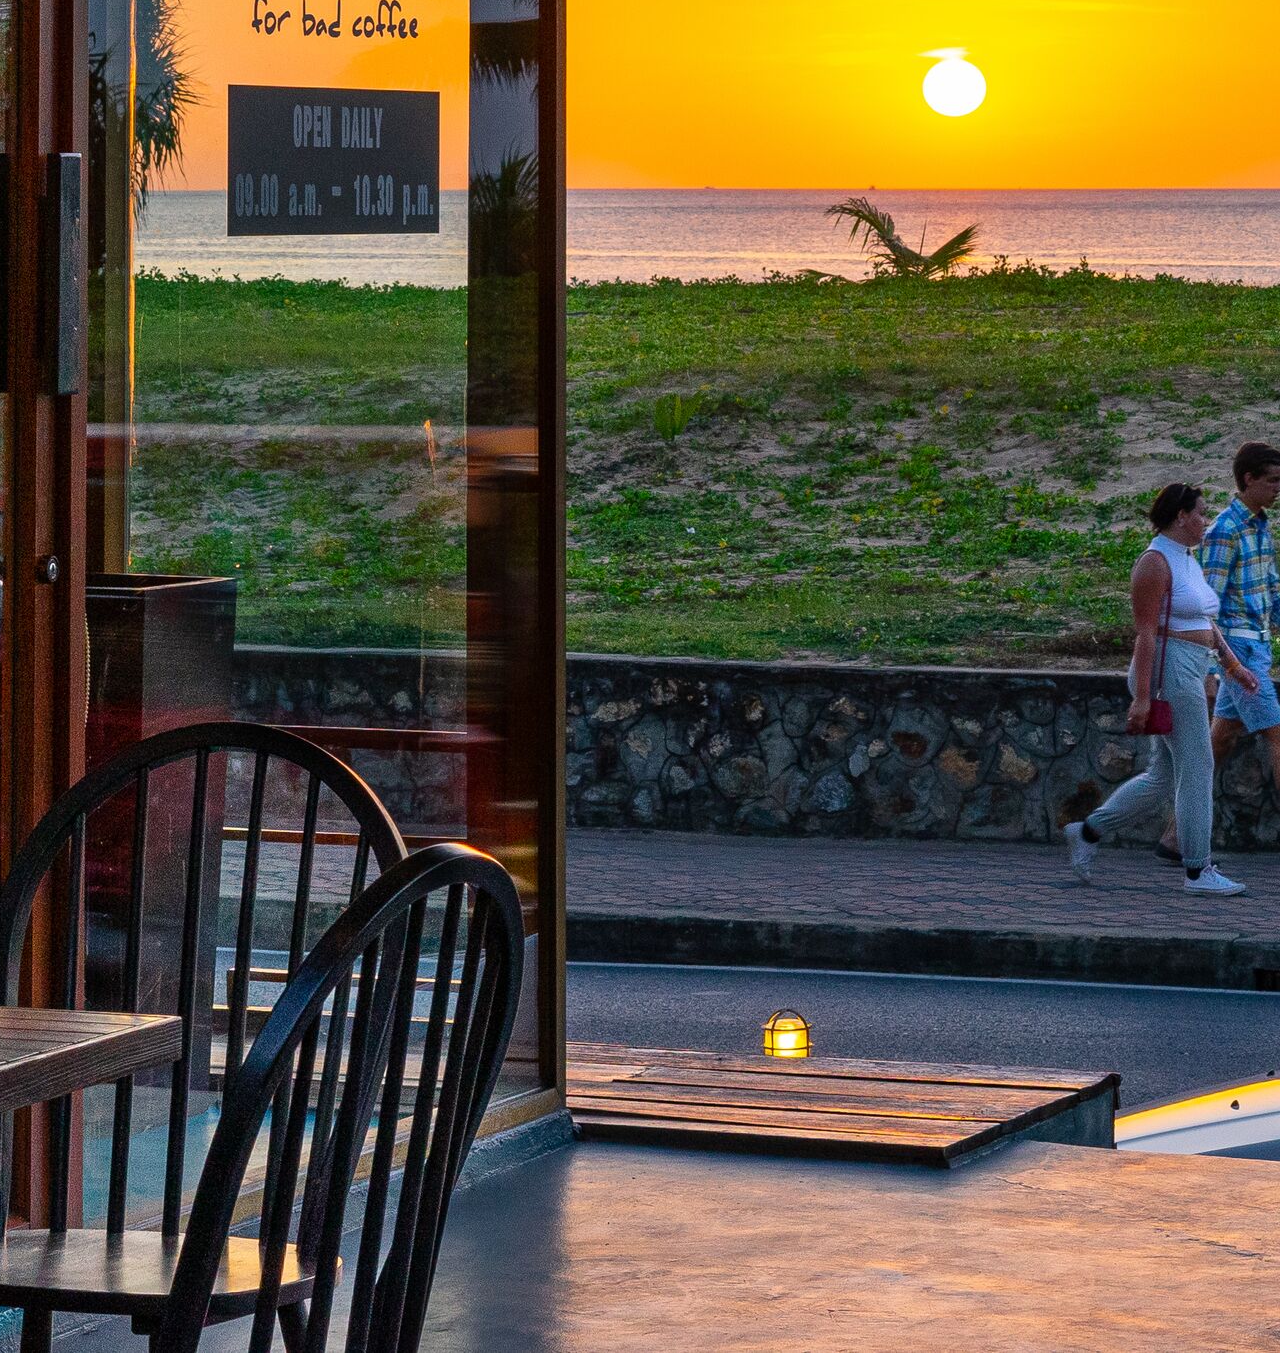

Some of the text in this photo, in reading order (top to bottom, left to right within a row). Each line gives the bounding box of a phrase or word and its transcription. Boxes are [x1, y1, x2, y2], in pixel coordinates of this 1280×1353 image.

[352, 0, 419, 39] coffee
[293, 104, 384, 149] OPEN DAILY
[234, 173, 279, 219] 09.00
[289, 182, 322, 217] a.m.
[353, 174, 395, 217] 10.30
[402, 182, 435, 225] p.m.
